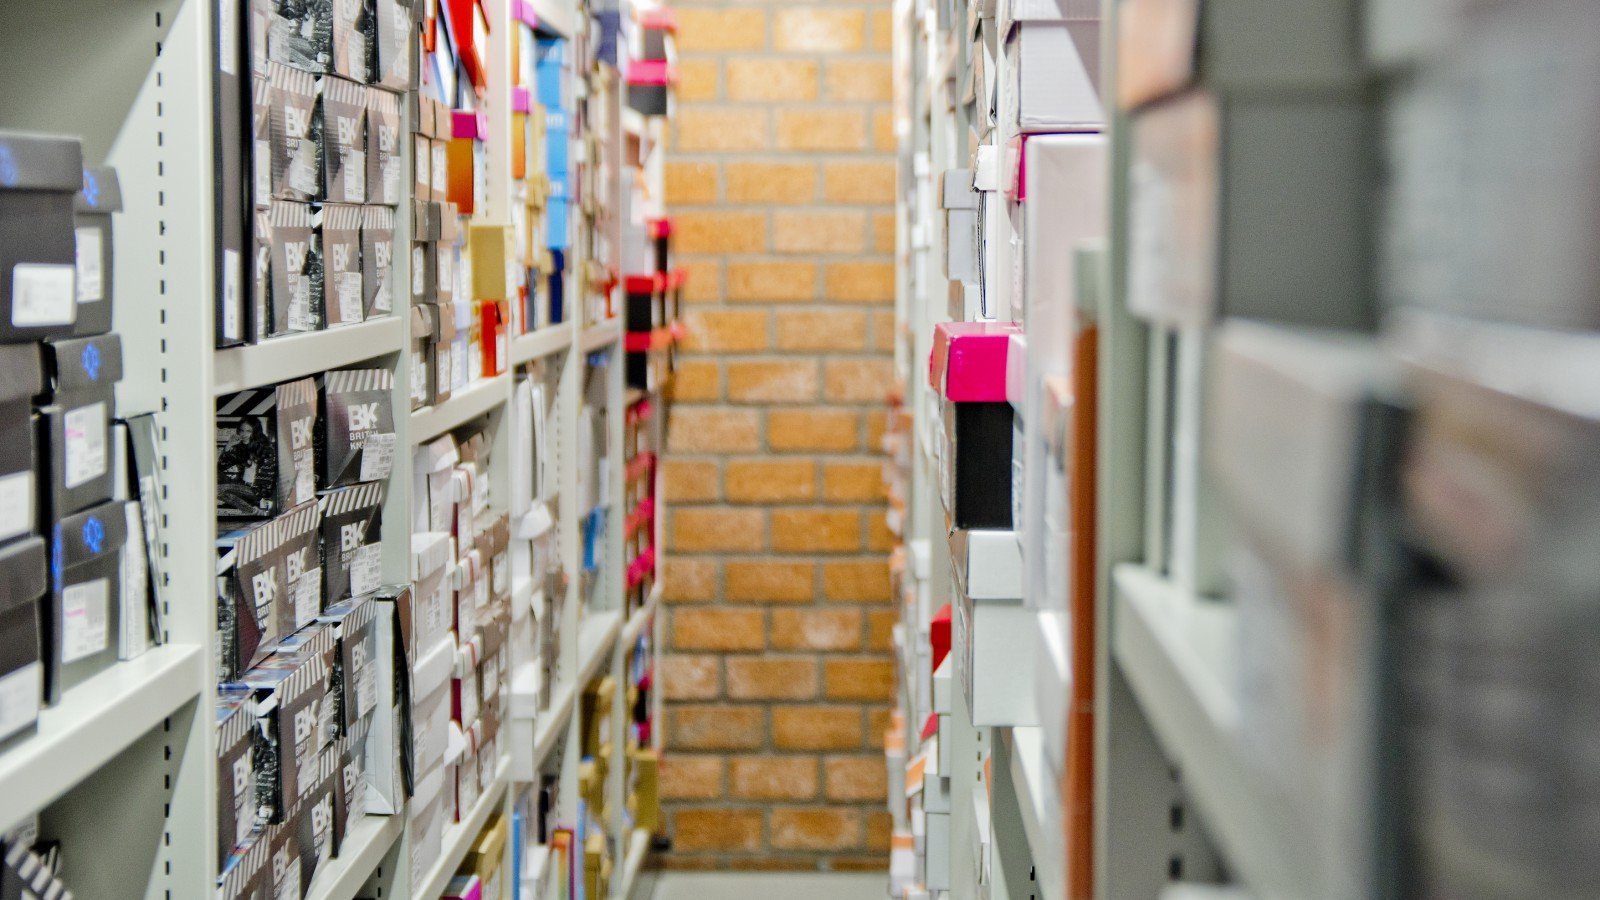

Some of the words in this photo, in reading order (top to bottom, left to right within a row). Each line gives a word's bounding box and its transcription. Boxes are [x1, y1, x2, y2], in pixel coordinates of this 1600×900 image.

[285, 106, 306, 137] BK
[338, 116, 356, 145] BK
[379, 125, 395, 151] BK
[285, 242, 304, 271] BK
[333, 244, 349, 272] BK
[375, 241, 391, 268] BK
[291, 416, 311, 450] BK
[348, 402, 379, 431] BK
[341, 520, 366, 552] BK
[287, 547, 307, 584] BK
[252, 566, 277, 607] BK
[352, 636, 367, 674] BK
[295, 700, 318, 745] BK
[233, 747, 253, 798] BK
[343, 755, 360, 794] BK
[312, 791, 332, 839] BK
[273, 838, 290, 888] BK
